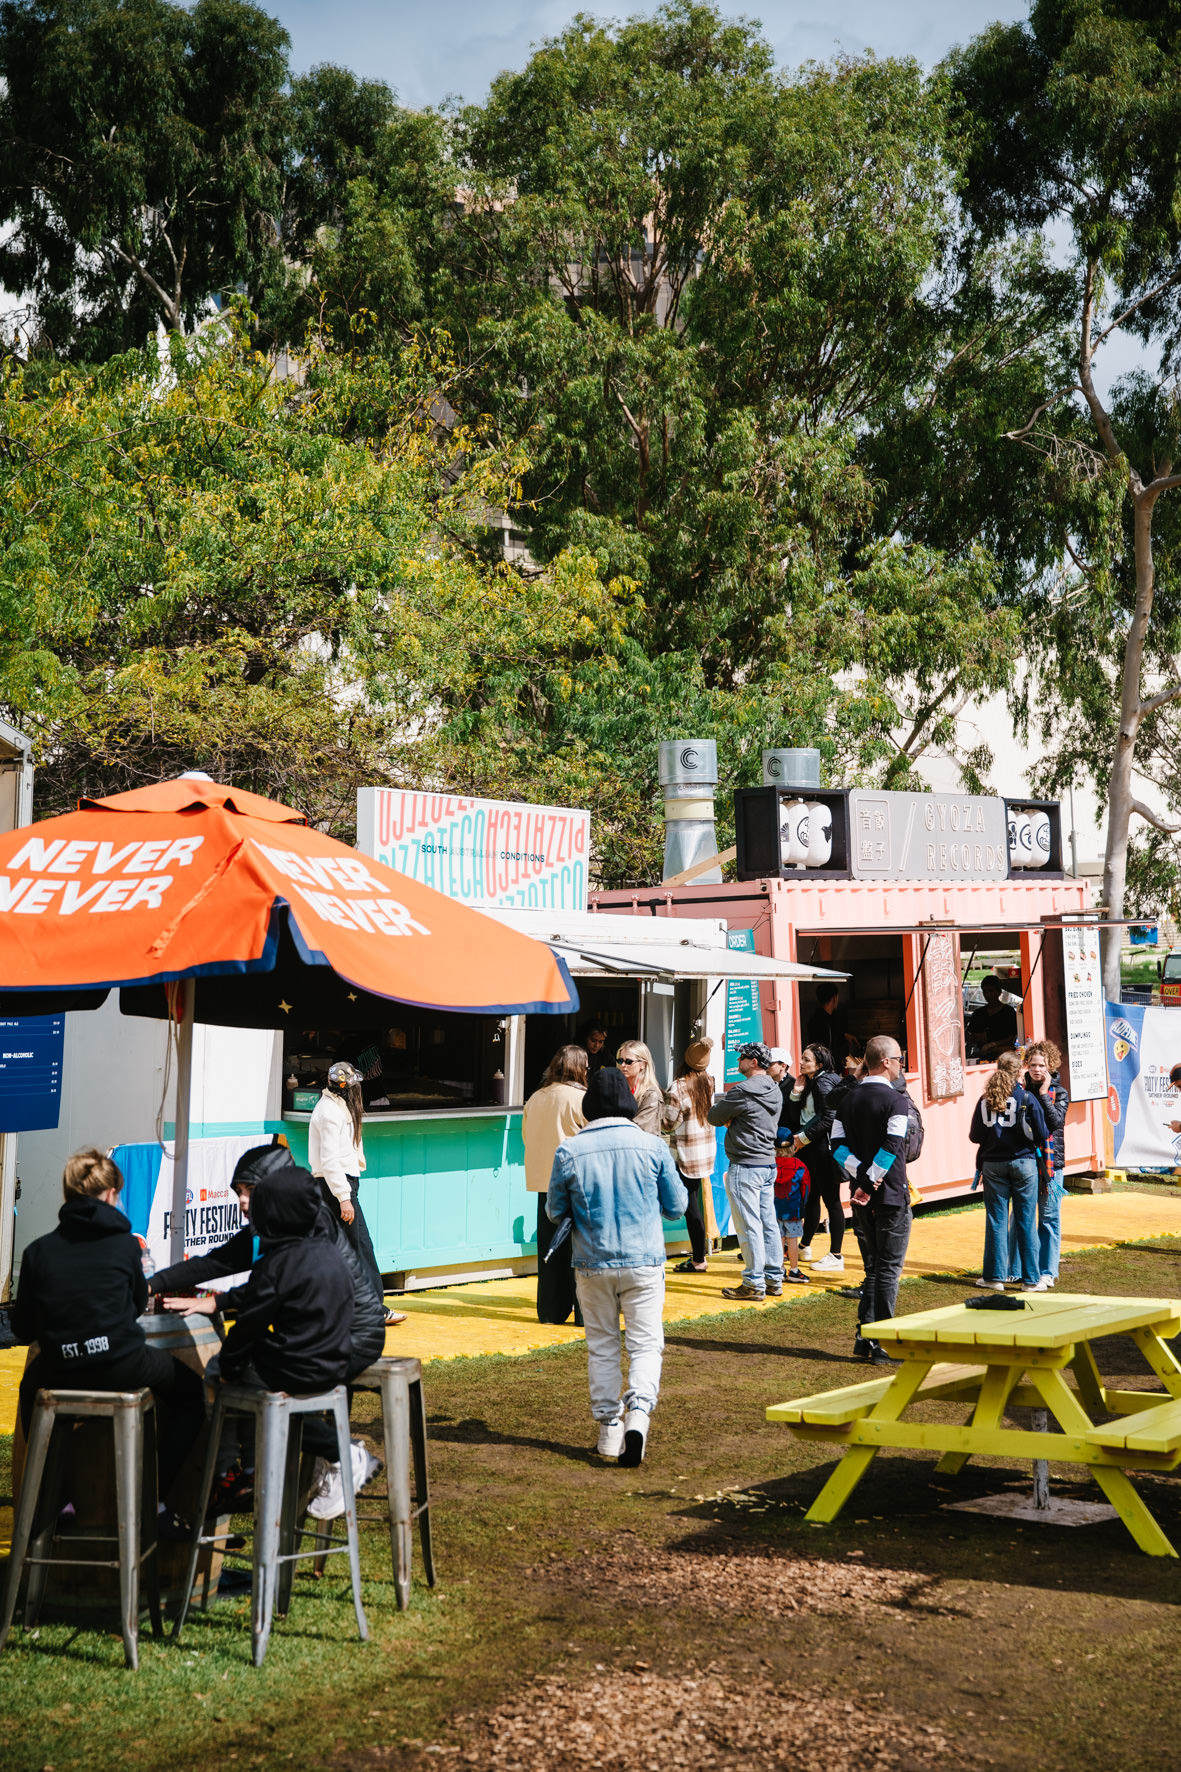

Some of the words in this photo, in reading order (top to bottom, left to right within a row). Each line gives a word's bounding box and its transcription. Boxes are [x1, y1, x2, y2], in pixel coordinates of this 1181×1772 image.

[925, 803, 986, 833] GYOZA
[7, 835, 204, 875] NEVER
[248, 838, 391, 893] NEVER
[421, 844, 448, 854] SOUTH
[500, 851, 545, 862] CONDITIONS
[927, 843, 1005, 872] RECORDS
[0, 875, 174, 916] NEVER
[292, 883, 432, 936] NEVER
[729, 934, 747, 948] ORDER
[1164, 986, 1179, 996] OVER
[981, 1097, 1017, 1127] 03
[163, 1208, 197, 1240] FTY
[184, 1236, 206, 1247] THER
[62, 1343, 83, 1358] EST.
[84, 1336, 109, 1354] 1998
